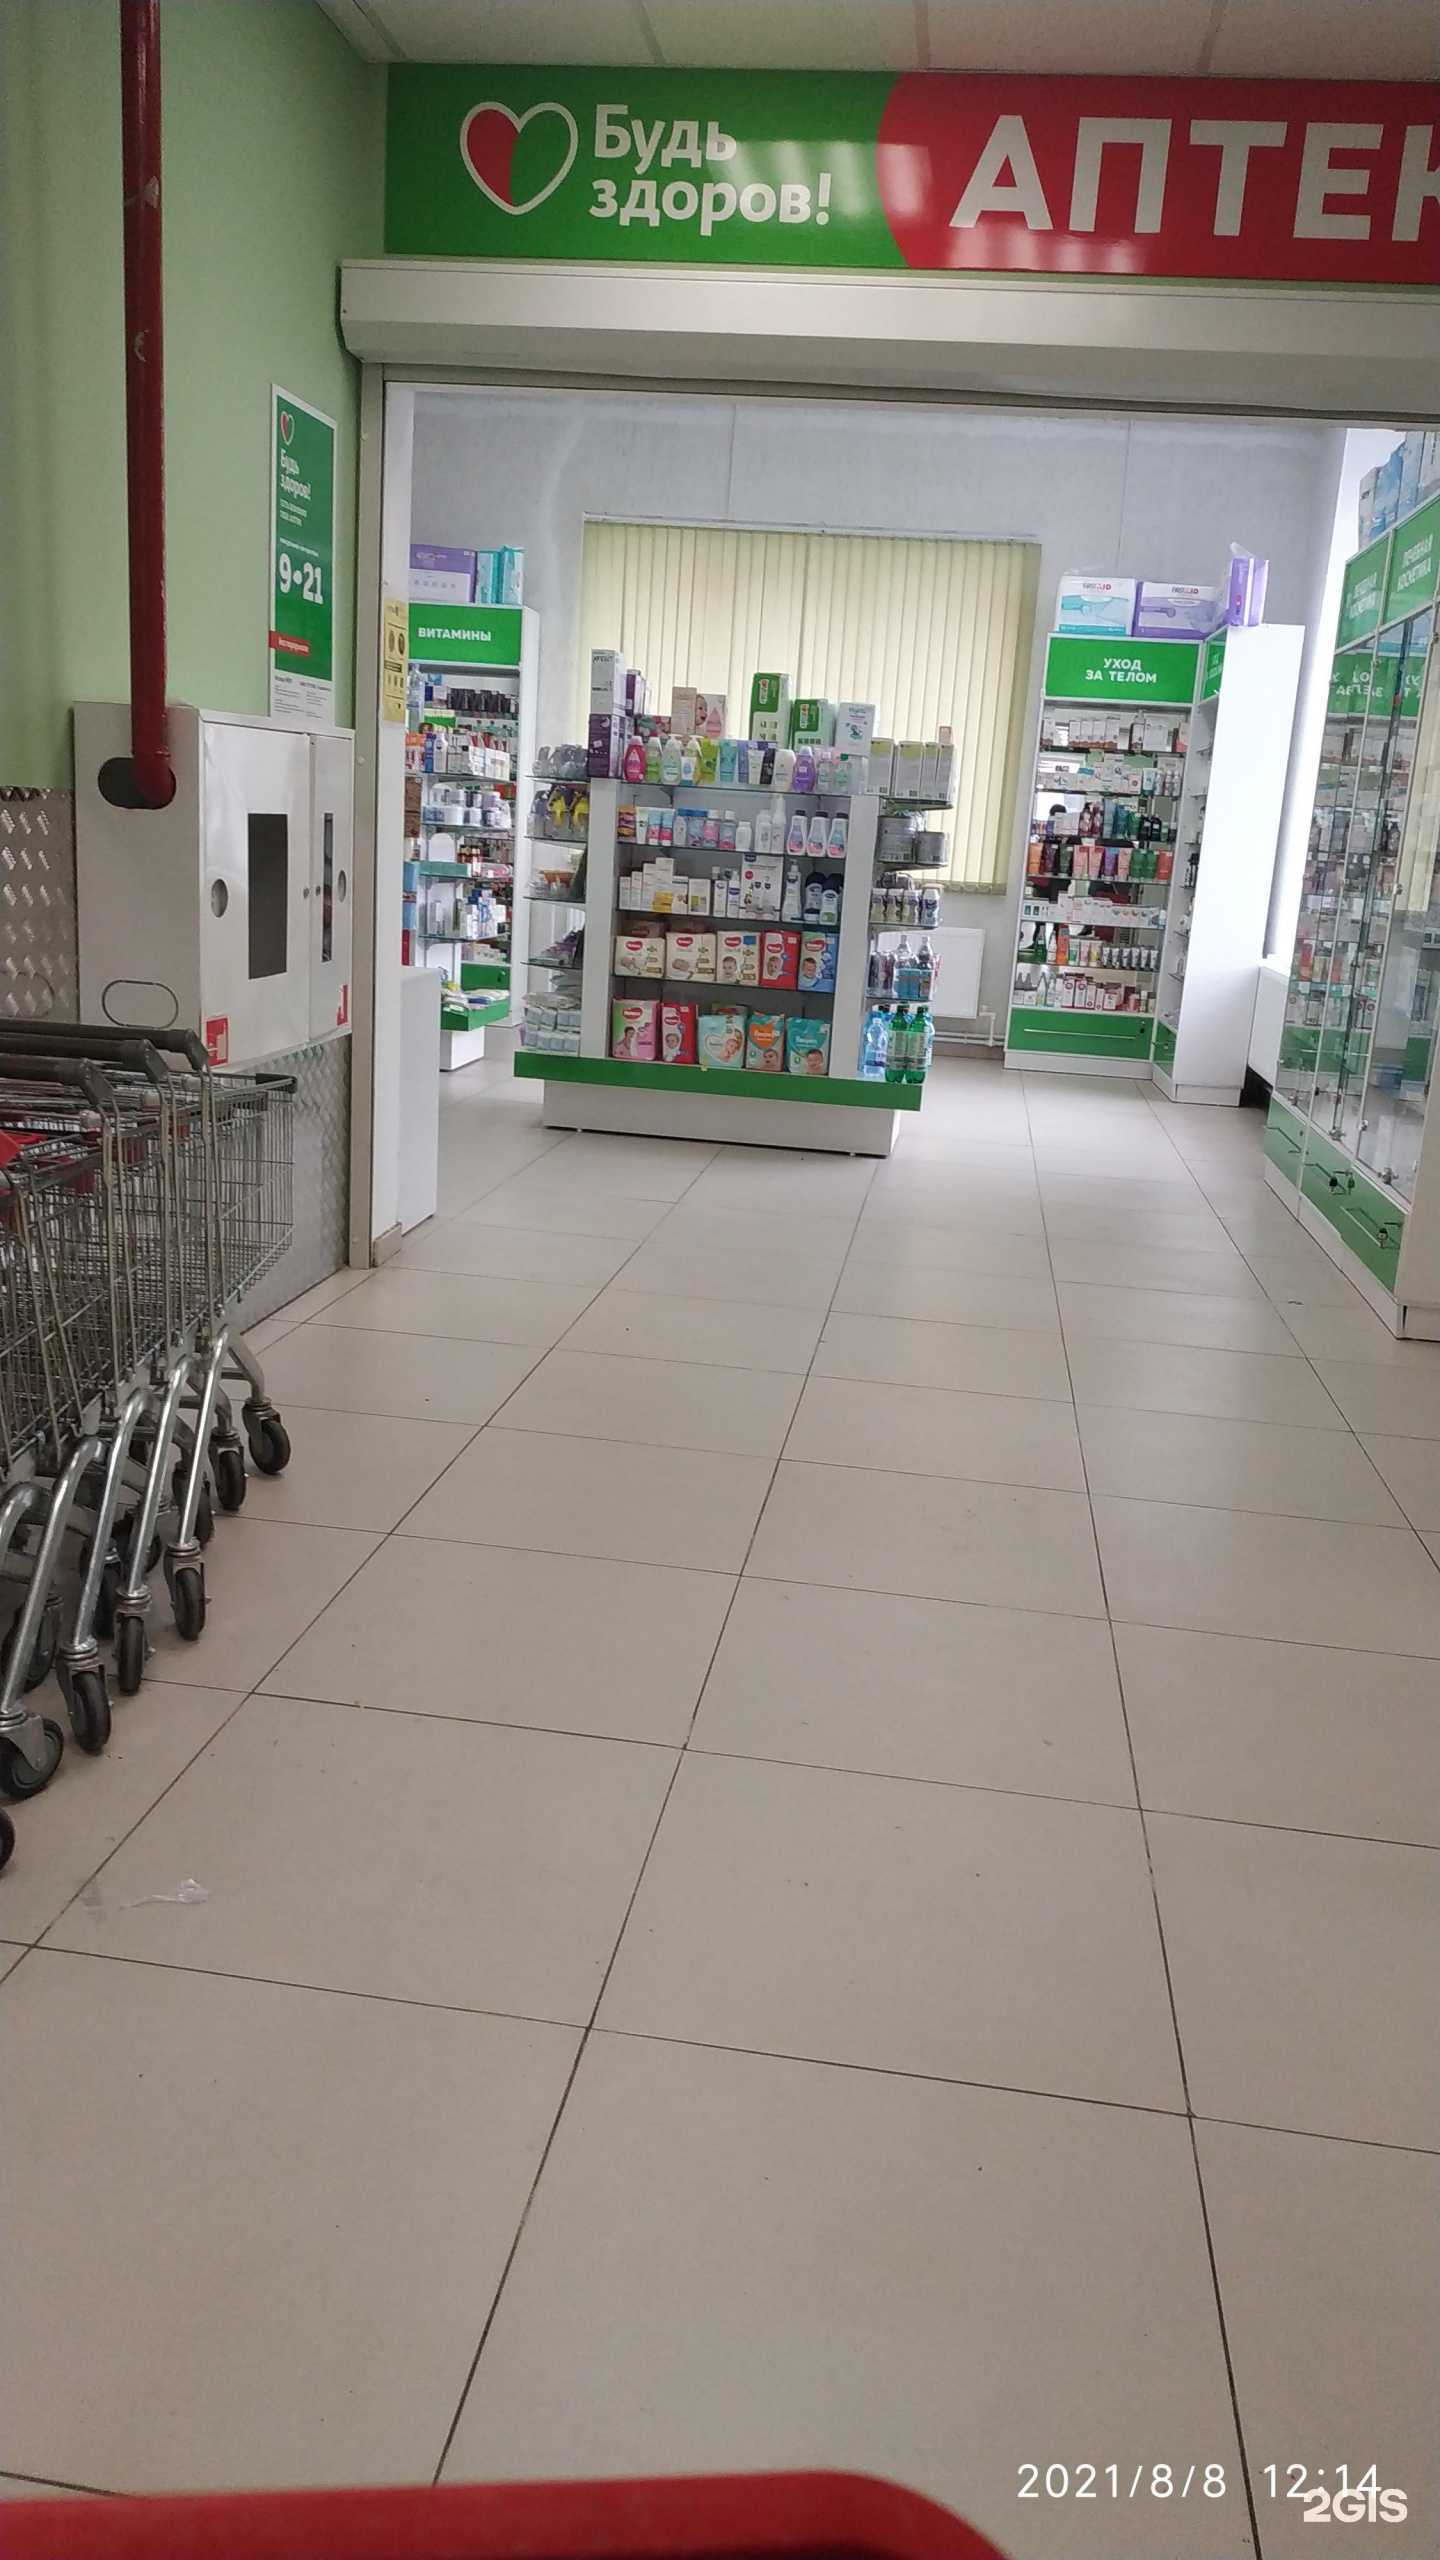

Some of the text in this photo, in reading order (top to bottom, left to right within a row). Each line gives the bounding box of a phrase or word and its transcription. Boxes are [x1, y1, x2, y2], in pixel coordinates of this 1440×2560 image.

[593, 104, 737, 174] Будь
[588, 173, 832, 236] здоров!
[417, 627, 492, 641] ВИТАМИНЫ
[1103, 657, 1142, 672] УХОД
[1085, 669, 1158, 684] ЗА ТЕЛОМ
